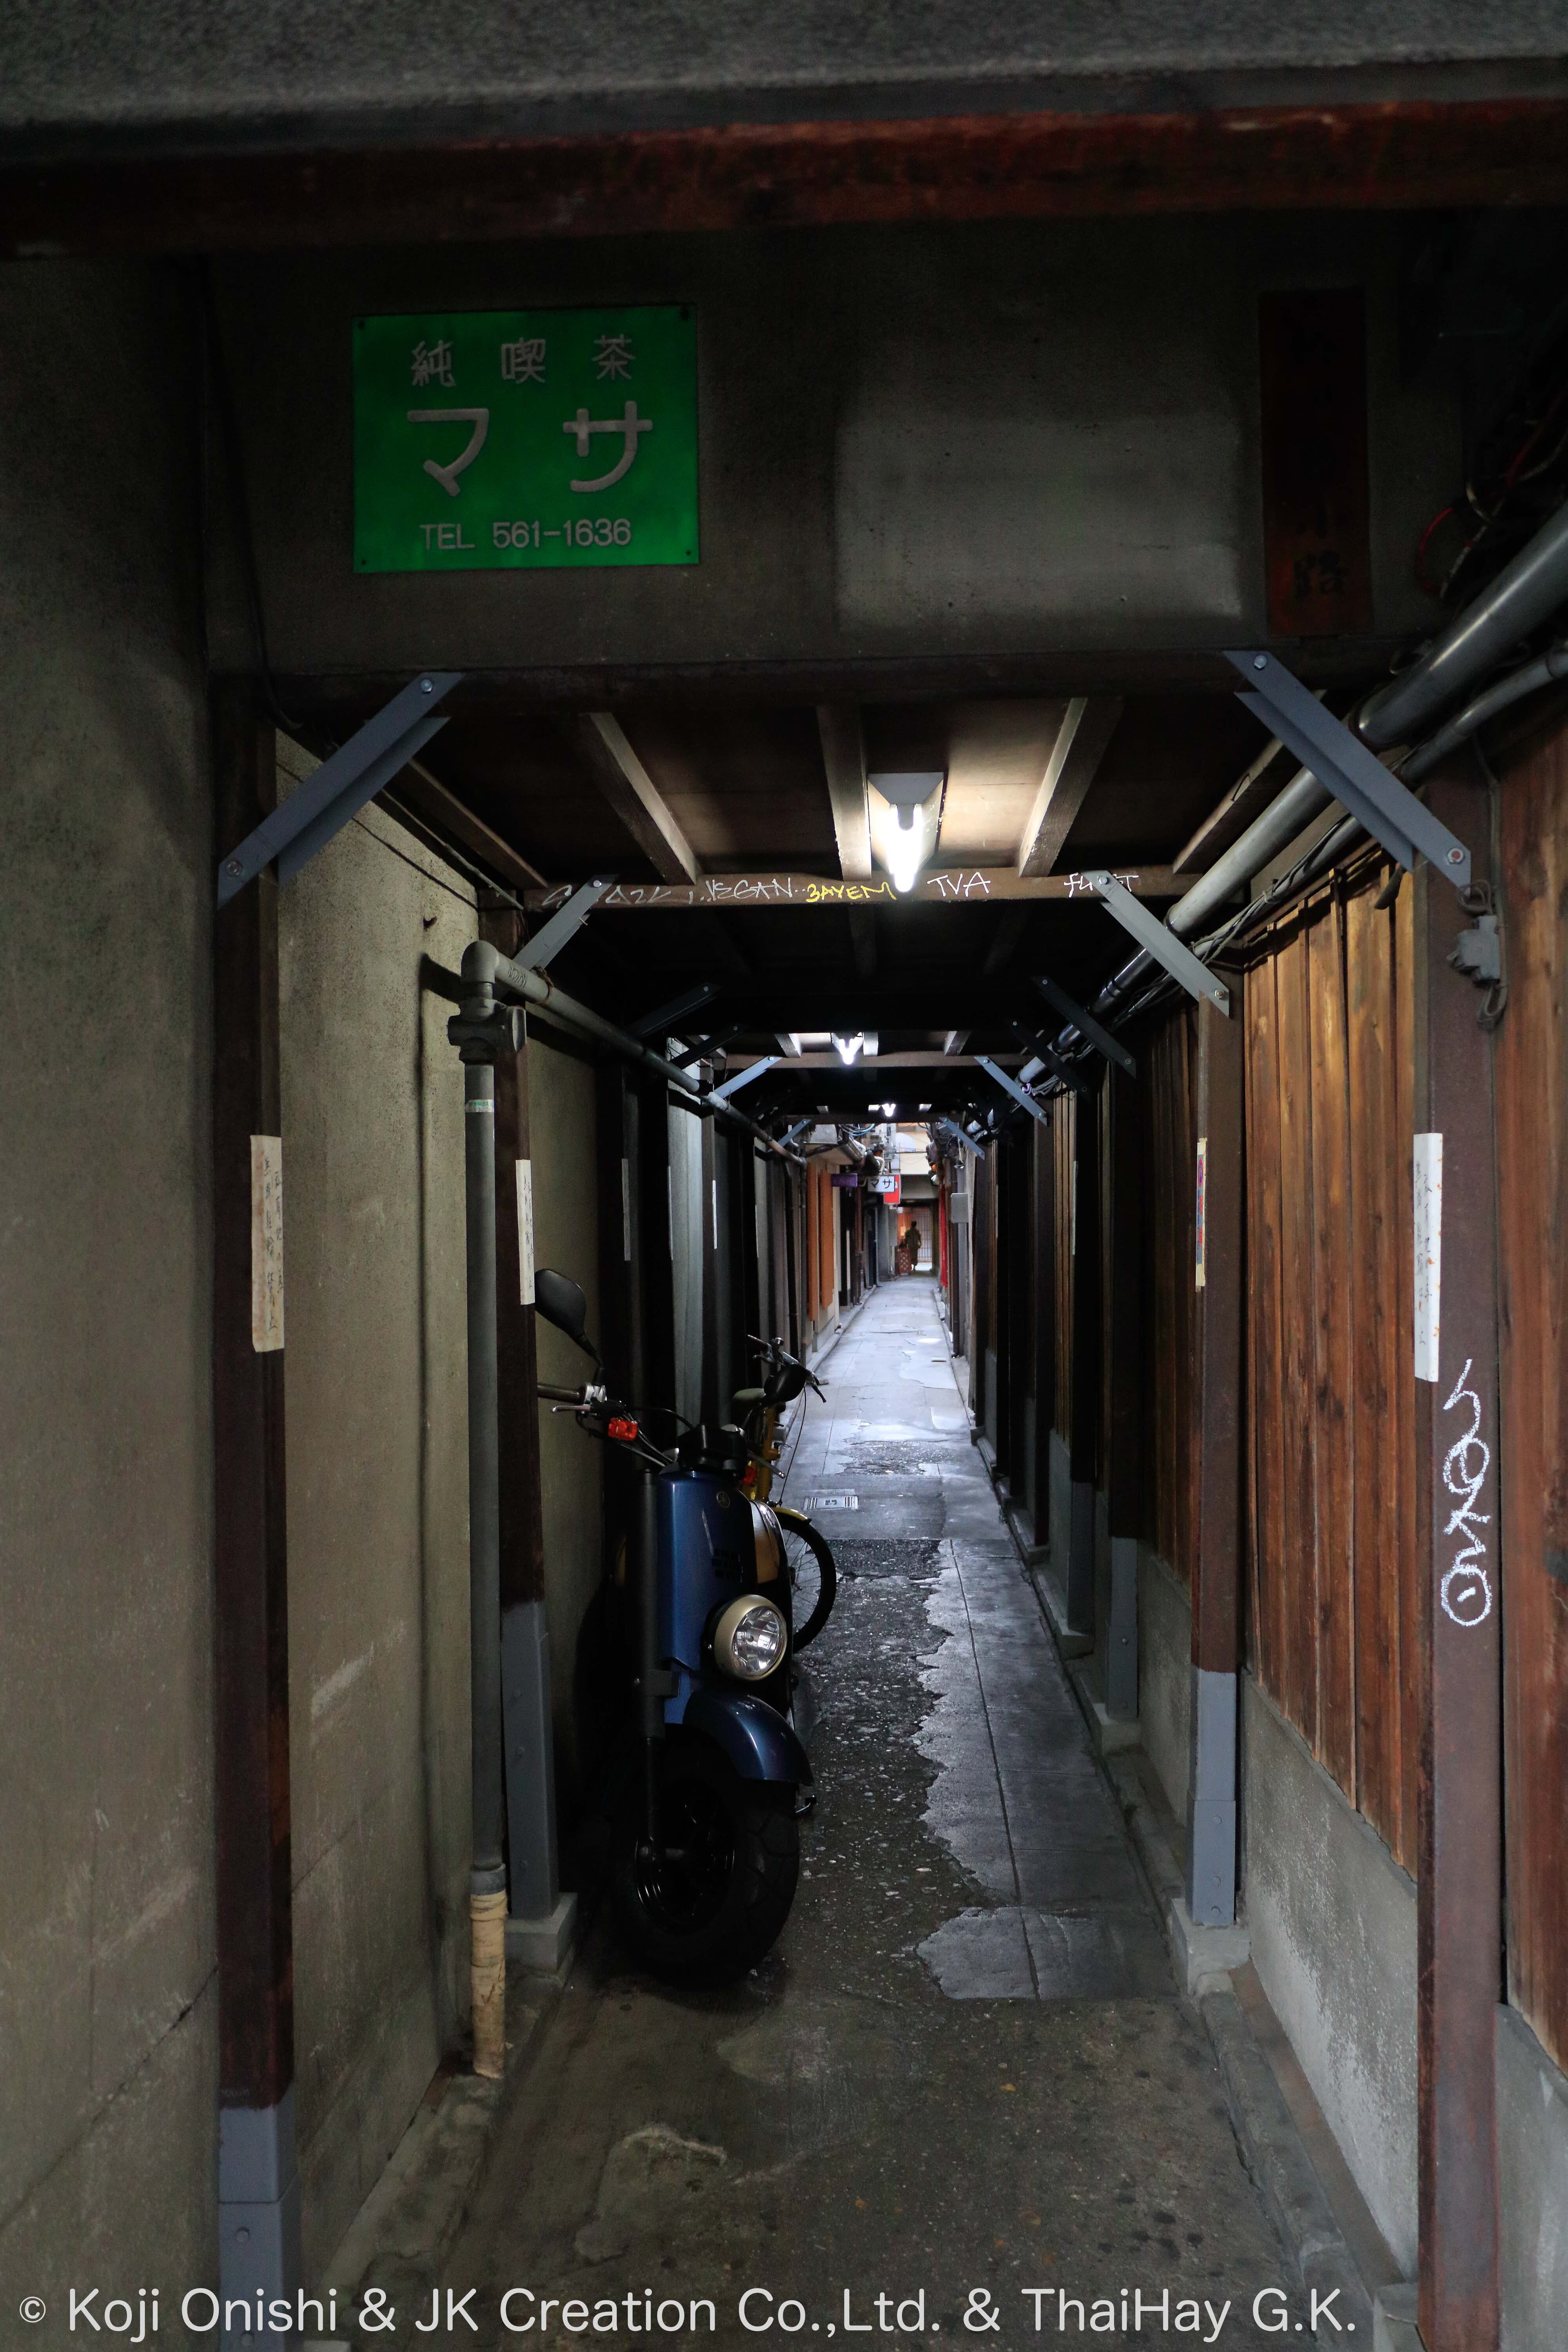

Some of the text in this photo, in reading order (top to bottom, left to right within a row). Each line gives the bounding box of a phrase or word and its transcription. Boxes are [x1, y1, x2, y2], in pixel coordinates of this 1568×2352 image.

[411, 334, 635, 387] 純喫茶
[407, 400, 653, 497] マサ
[419, 517, 632, 550] TEL 561-1636
[869, 1178, 892, 1189] マサ
